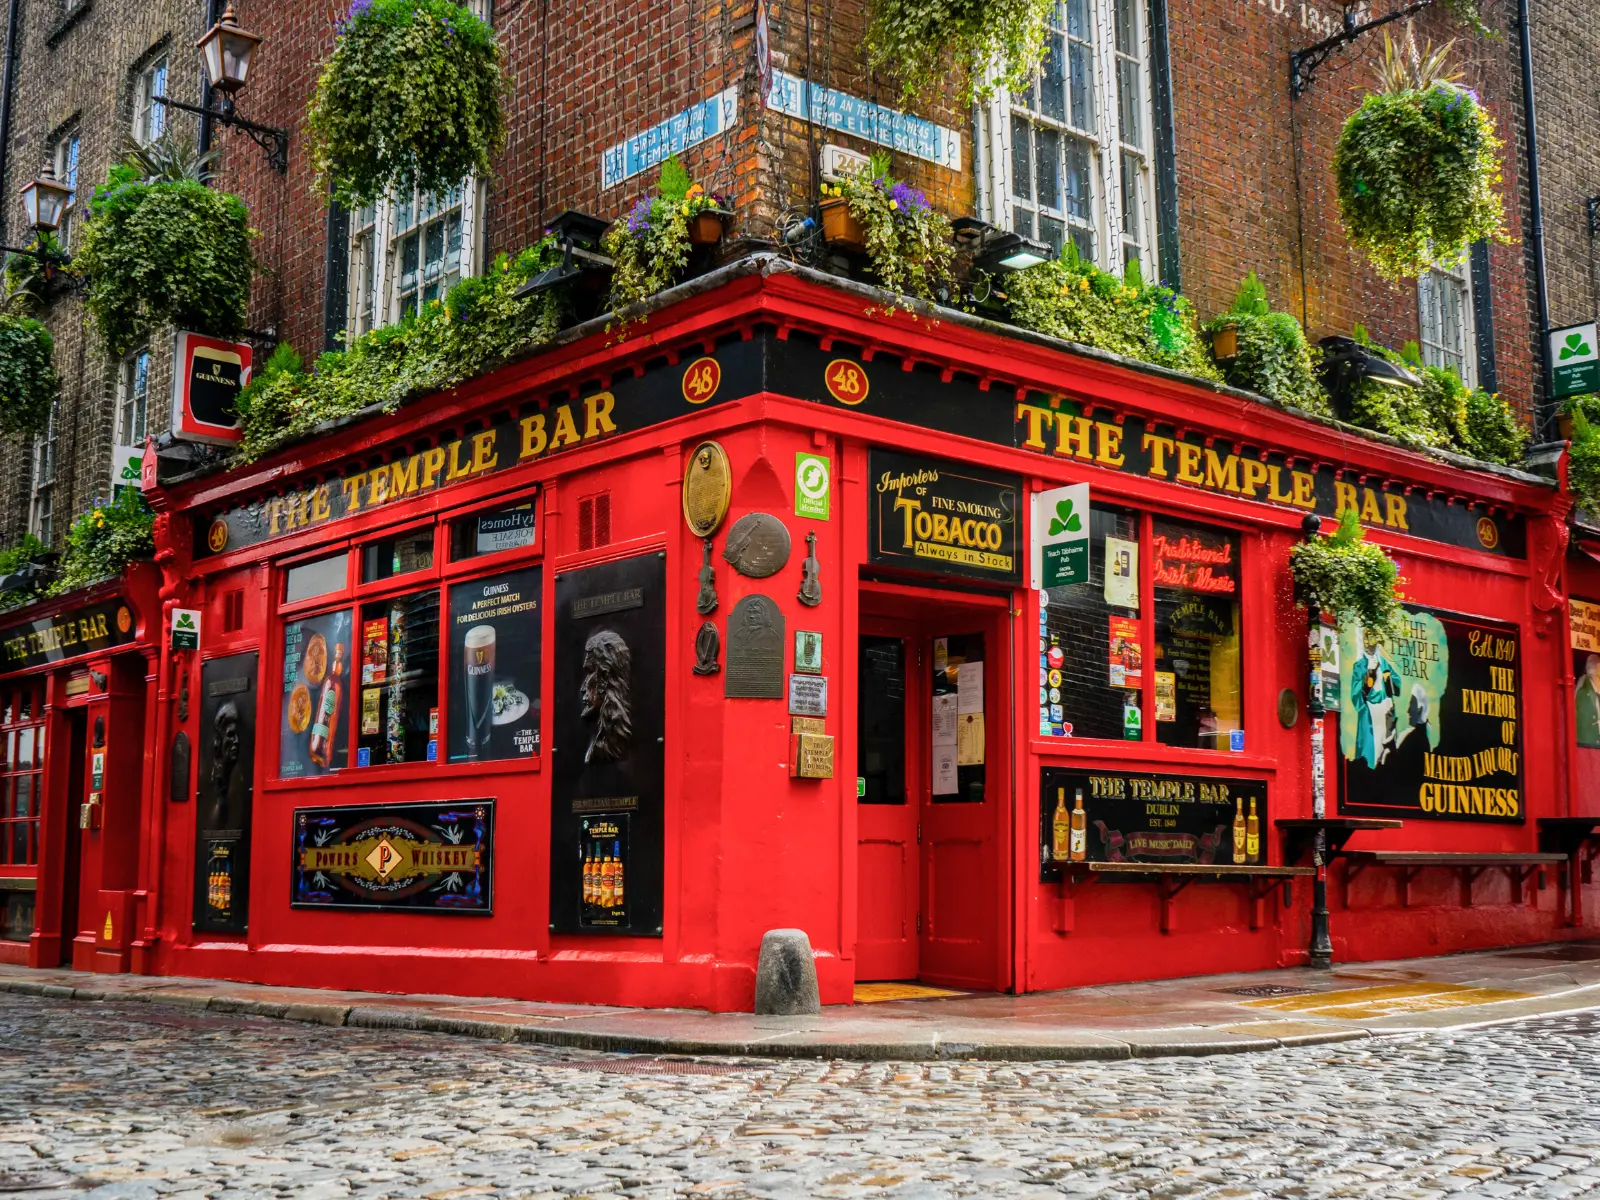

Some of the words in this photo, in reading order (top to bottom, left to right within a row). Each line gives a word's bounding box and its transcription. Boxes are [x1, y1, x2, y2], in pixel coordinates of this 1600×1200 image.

[840, 99, 853, 113] AN
[895, 133, 933, 156] SOUTH
[196, 372, 236, 387] GUINNESS
[688, 366, 713, 396] 48
[832, 365, 860, 394] 48
[267, 484, 332, 536] THE
[343, 428, 498, 511] TEMPLE
[519, 390, 617, 460] BAR
[1017, 402, 1125, 467] THE
[1143, 432, 1317, 509] TEMPLE
[1334, 480, 1409, 531] BAR
[876, 468, 939, 497] Importers
[916, 486, 928, 496] OF
[801, 503, 825, 514] Member
[803, 496, 823, 507] Official
[932, 496, 955, 511] FINE
[957, 500, 1002, 519] SMOKING
[893, 496, 1003, 551] TOBACCO
[1479, 523, 1493, 540] 48
[917, 542, 959, 560] Always
[964, 548, 975, 562] in
[979, 552, 1011, 569] Stock
[1047, 549, 1060, 558] Teach
[1152, 536, 1231, 564] Traditional
[1153, 559, 1189, 585] Irish
[1192, 567, 1235, 592] Music
[477, 597, 501, 610] PERFECT
[501, 592, 521, 604] MATCH
[483, 582, 509, 597] GUINNESS
[457, 614, 468, 624] FOR
[467, 609, 497, 623] DELICIOUS
[496, 606, 512, 617] IRISH
[512, 600, 537, 614] OYSTERS
[4, 636, 28, 660] THE
[28, 622, 78, 655] TEMPLE
[79, 613, 109, 642] BAR
[1576, 634, 1591, 649] Area
[1391, 636, 1440, 662] TEMPLE
[1495, 638, 1515, 662] 1840
[468, 662, 492, 676] GUINNESS
[1402, 658, 1429, 681] BAR
[1490, 666, 1515, 692] THE
[1462, 688, 1516, 719] EMPEROR
[513, 734, 540, 746] TEMPLE
[521, 729, 533, 737] THE
[1501, 720, 1515, 745] OF
[519, 743, 534, 753] BAR
[1424, 751, 1472, 782] MALTED
[1474, 746, 1519, 778] LIQUORS
[1089, 776, 1126, 800] THE
[1129, 778, 1195, 803] TEMPLE
[1199, 783, 1231, 804] BAR
[1419, 782, 1519, 817] GUINNESS
[1146, 804, 1180, 816] DUBLIN
[1149, 818, 1162, 828] EST.
[1164, 820, 1177, 828] 1840
[1129, 839, 1148, 850] LIVE
[1149, 840, 1172, 850] MUSIC
[1172, 840, 1196, 850] DAILY
[316, 851, 359, 868] POWERS
[378, 845, 392, 873] P
[412, 850, 468, 867] WHISKEY
